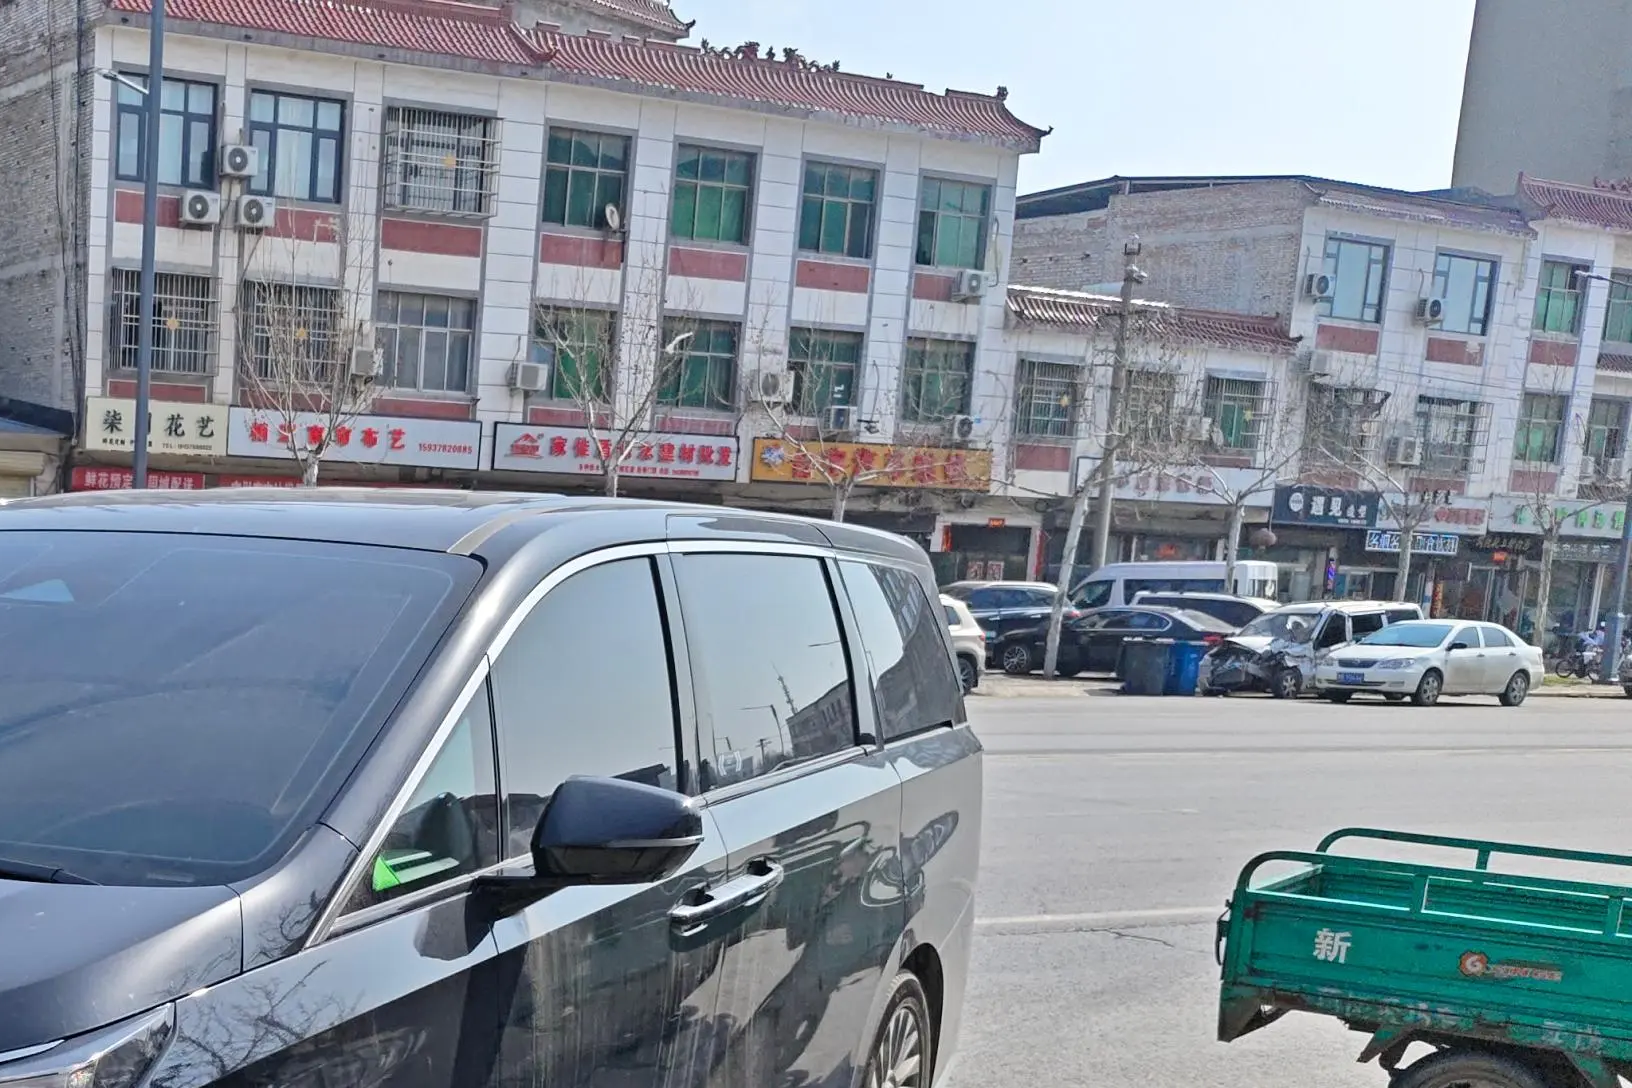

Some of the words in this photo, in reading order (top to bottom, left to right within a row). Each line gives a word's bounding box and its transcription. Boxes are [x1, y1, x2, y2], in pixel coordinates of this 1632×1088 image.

[103, 409, 215, 438] 柒花艺
[1312, 928, 1352, 964] 新
